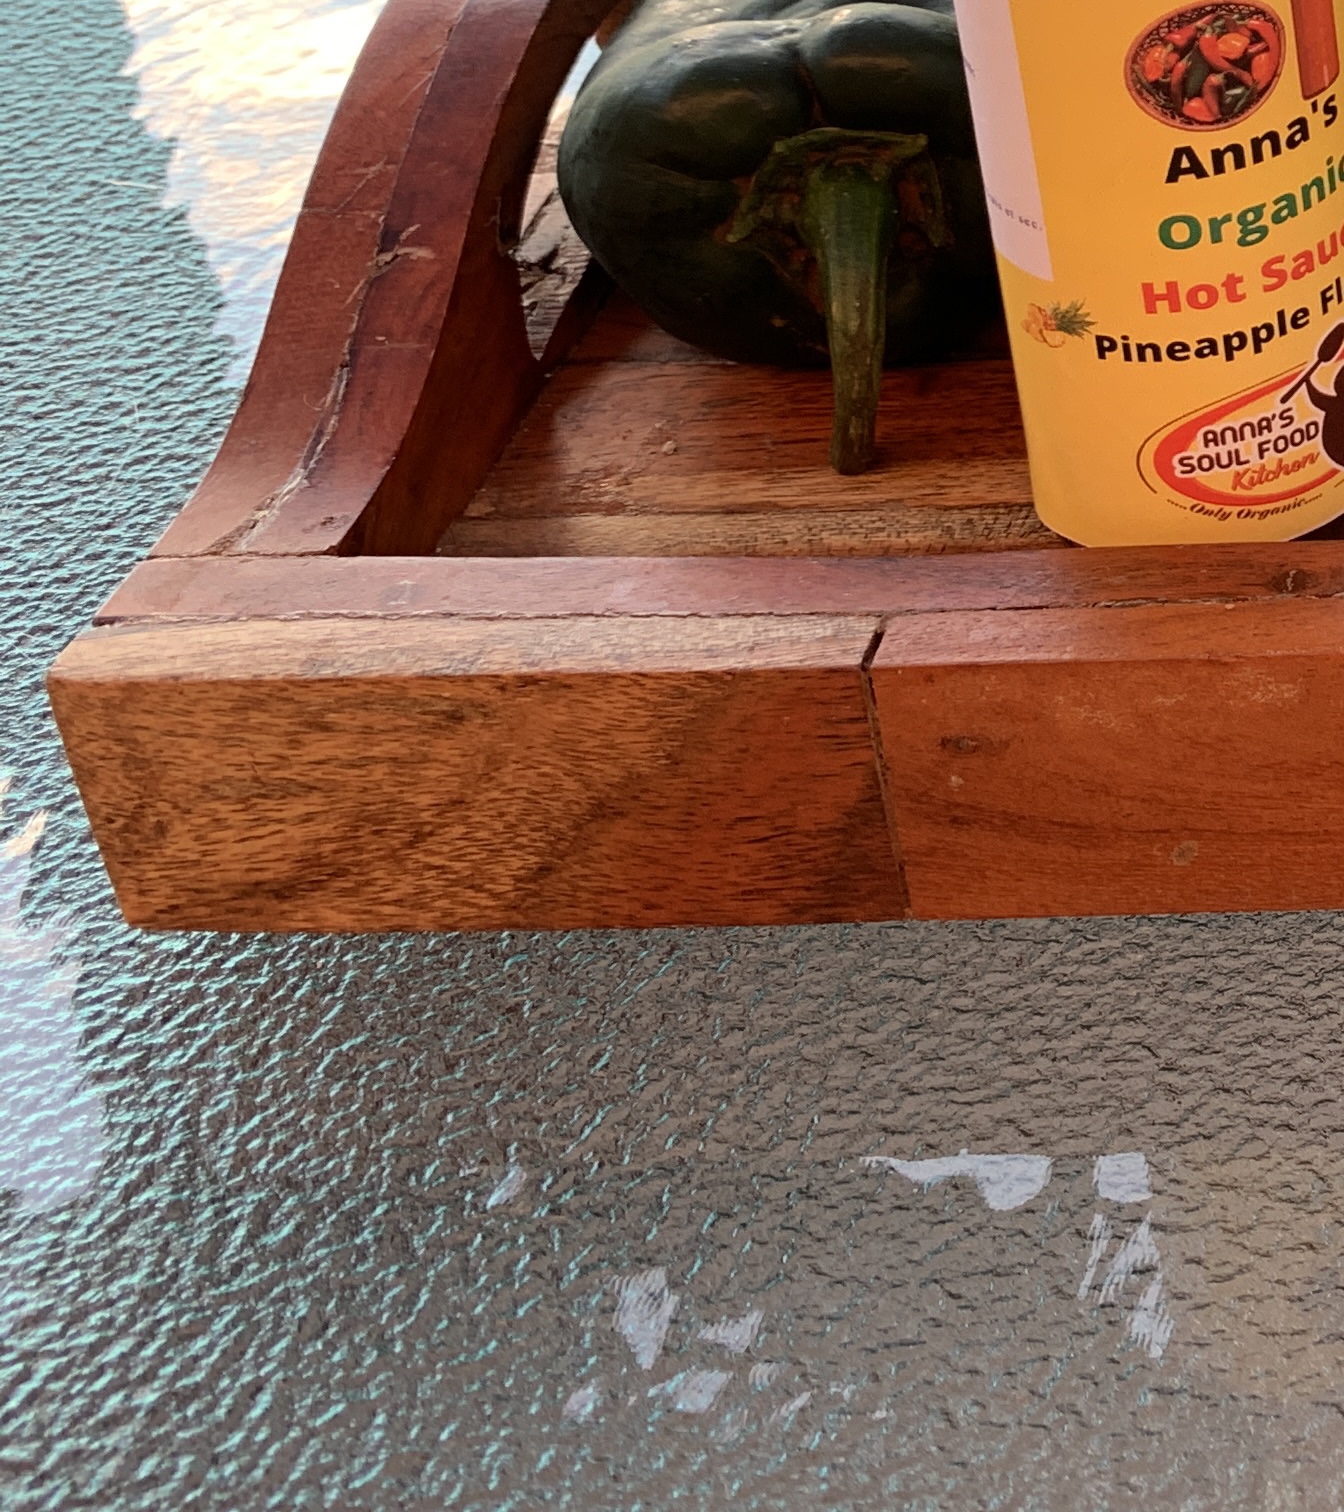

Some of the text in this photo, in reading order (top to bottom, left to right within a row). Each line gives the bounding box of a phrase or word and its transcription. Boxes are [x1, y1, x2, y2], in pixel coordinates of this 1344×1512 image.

[1165, 93, 1338, 184] Anna's
[1141, 272, 1247, 315] Hot
[1095, 306, 1310, 363] Pineapple
[1178, 420, 1319, 475] SOUL FOOD
[1203, 407, 1295, 449] ANNA'S
[1231, 451, 1319, 491] Kitchen
[1190, 502, 1233, 522] Only
